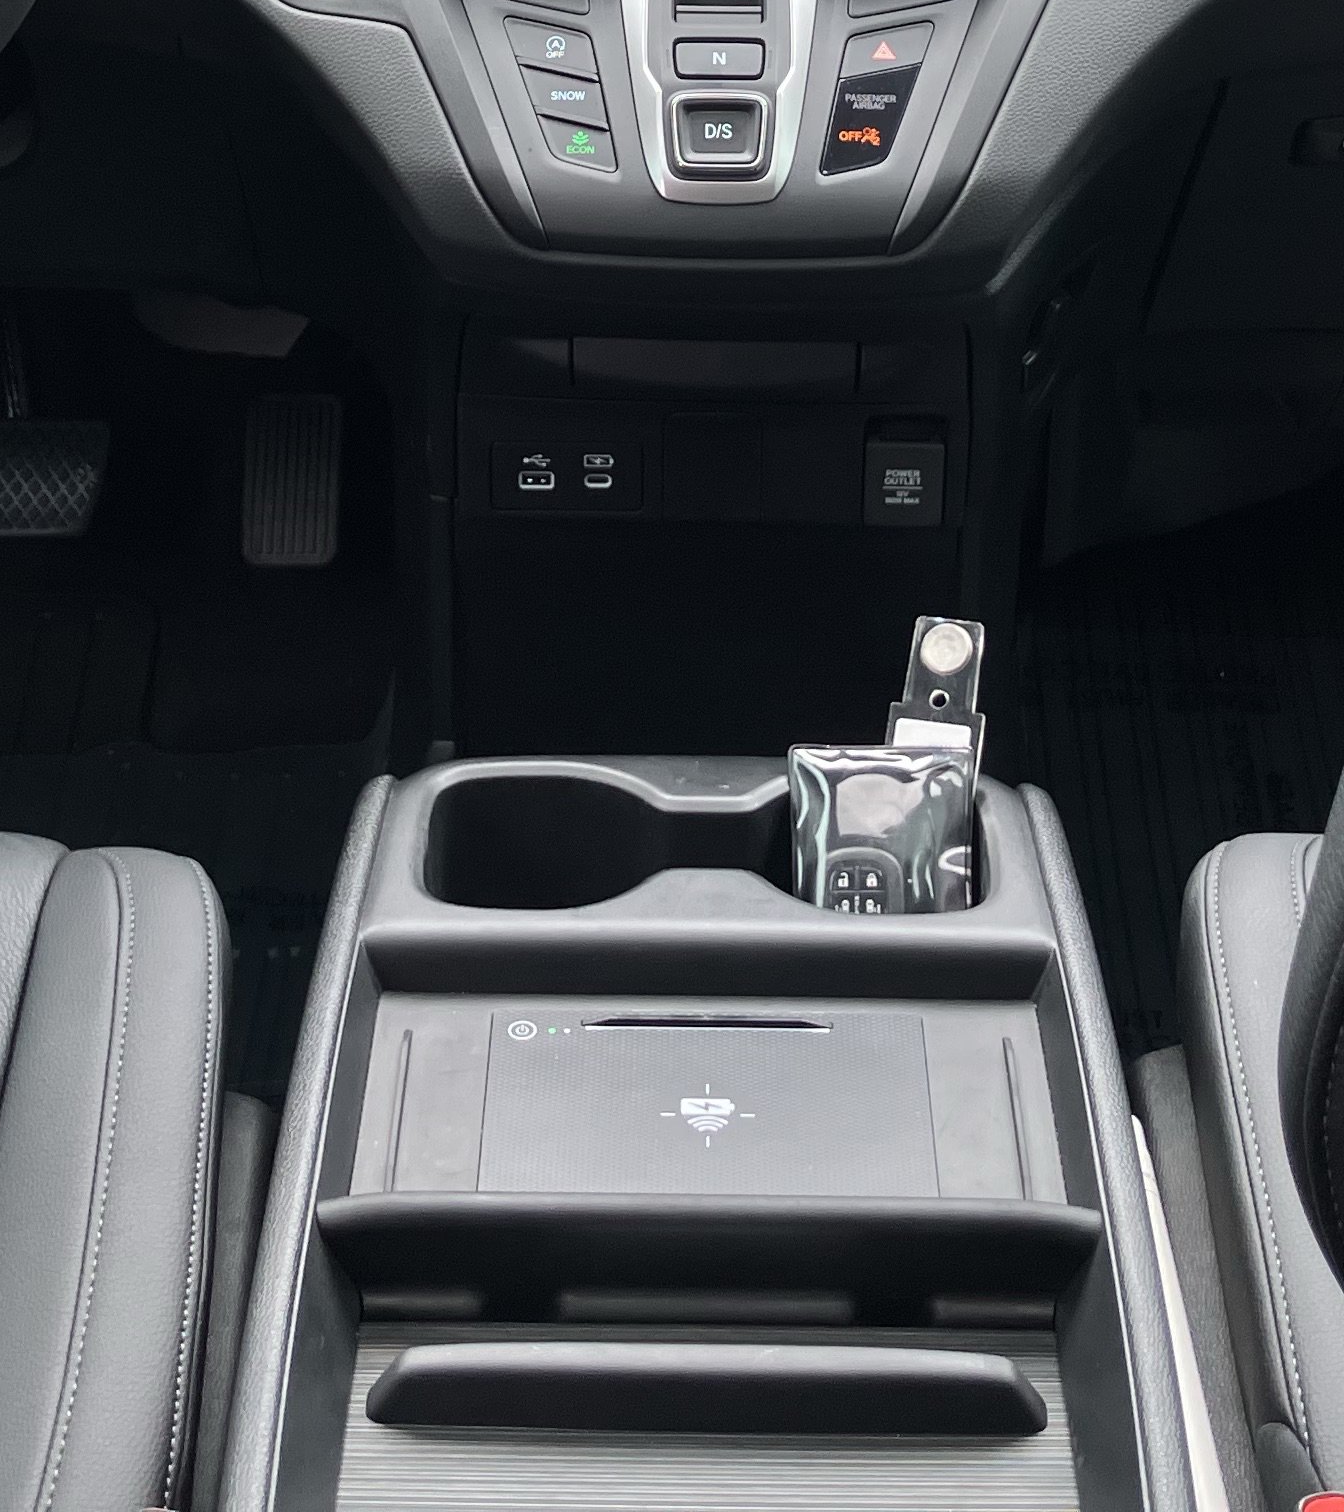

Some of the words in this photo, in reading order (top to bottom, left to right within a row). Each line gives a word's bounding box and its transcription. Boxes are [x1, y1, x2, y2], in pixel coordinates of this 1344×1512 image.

[712, 51, 726, 65] N
[550, 90, 586, 101] SNOW
[844, 93, 897, 103] PASSENGER
[852, 101, 886, 110] AIRBAG
[704, 123, 733, 139] D/S
[838, 130, 863, 142] OFF
[566, 145, 595, 154] ECON
[885, 469, 921, 477] POWER
[884, 477, 921, 485] OUTLET
